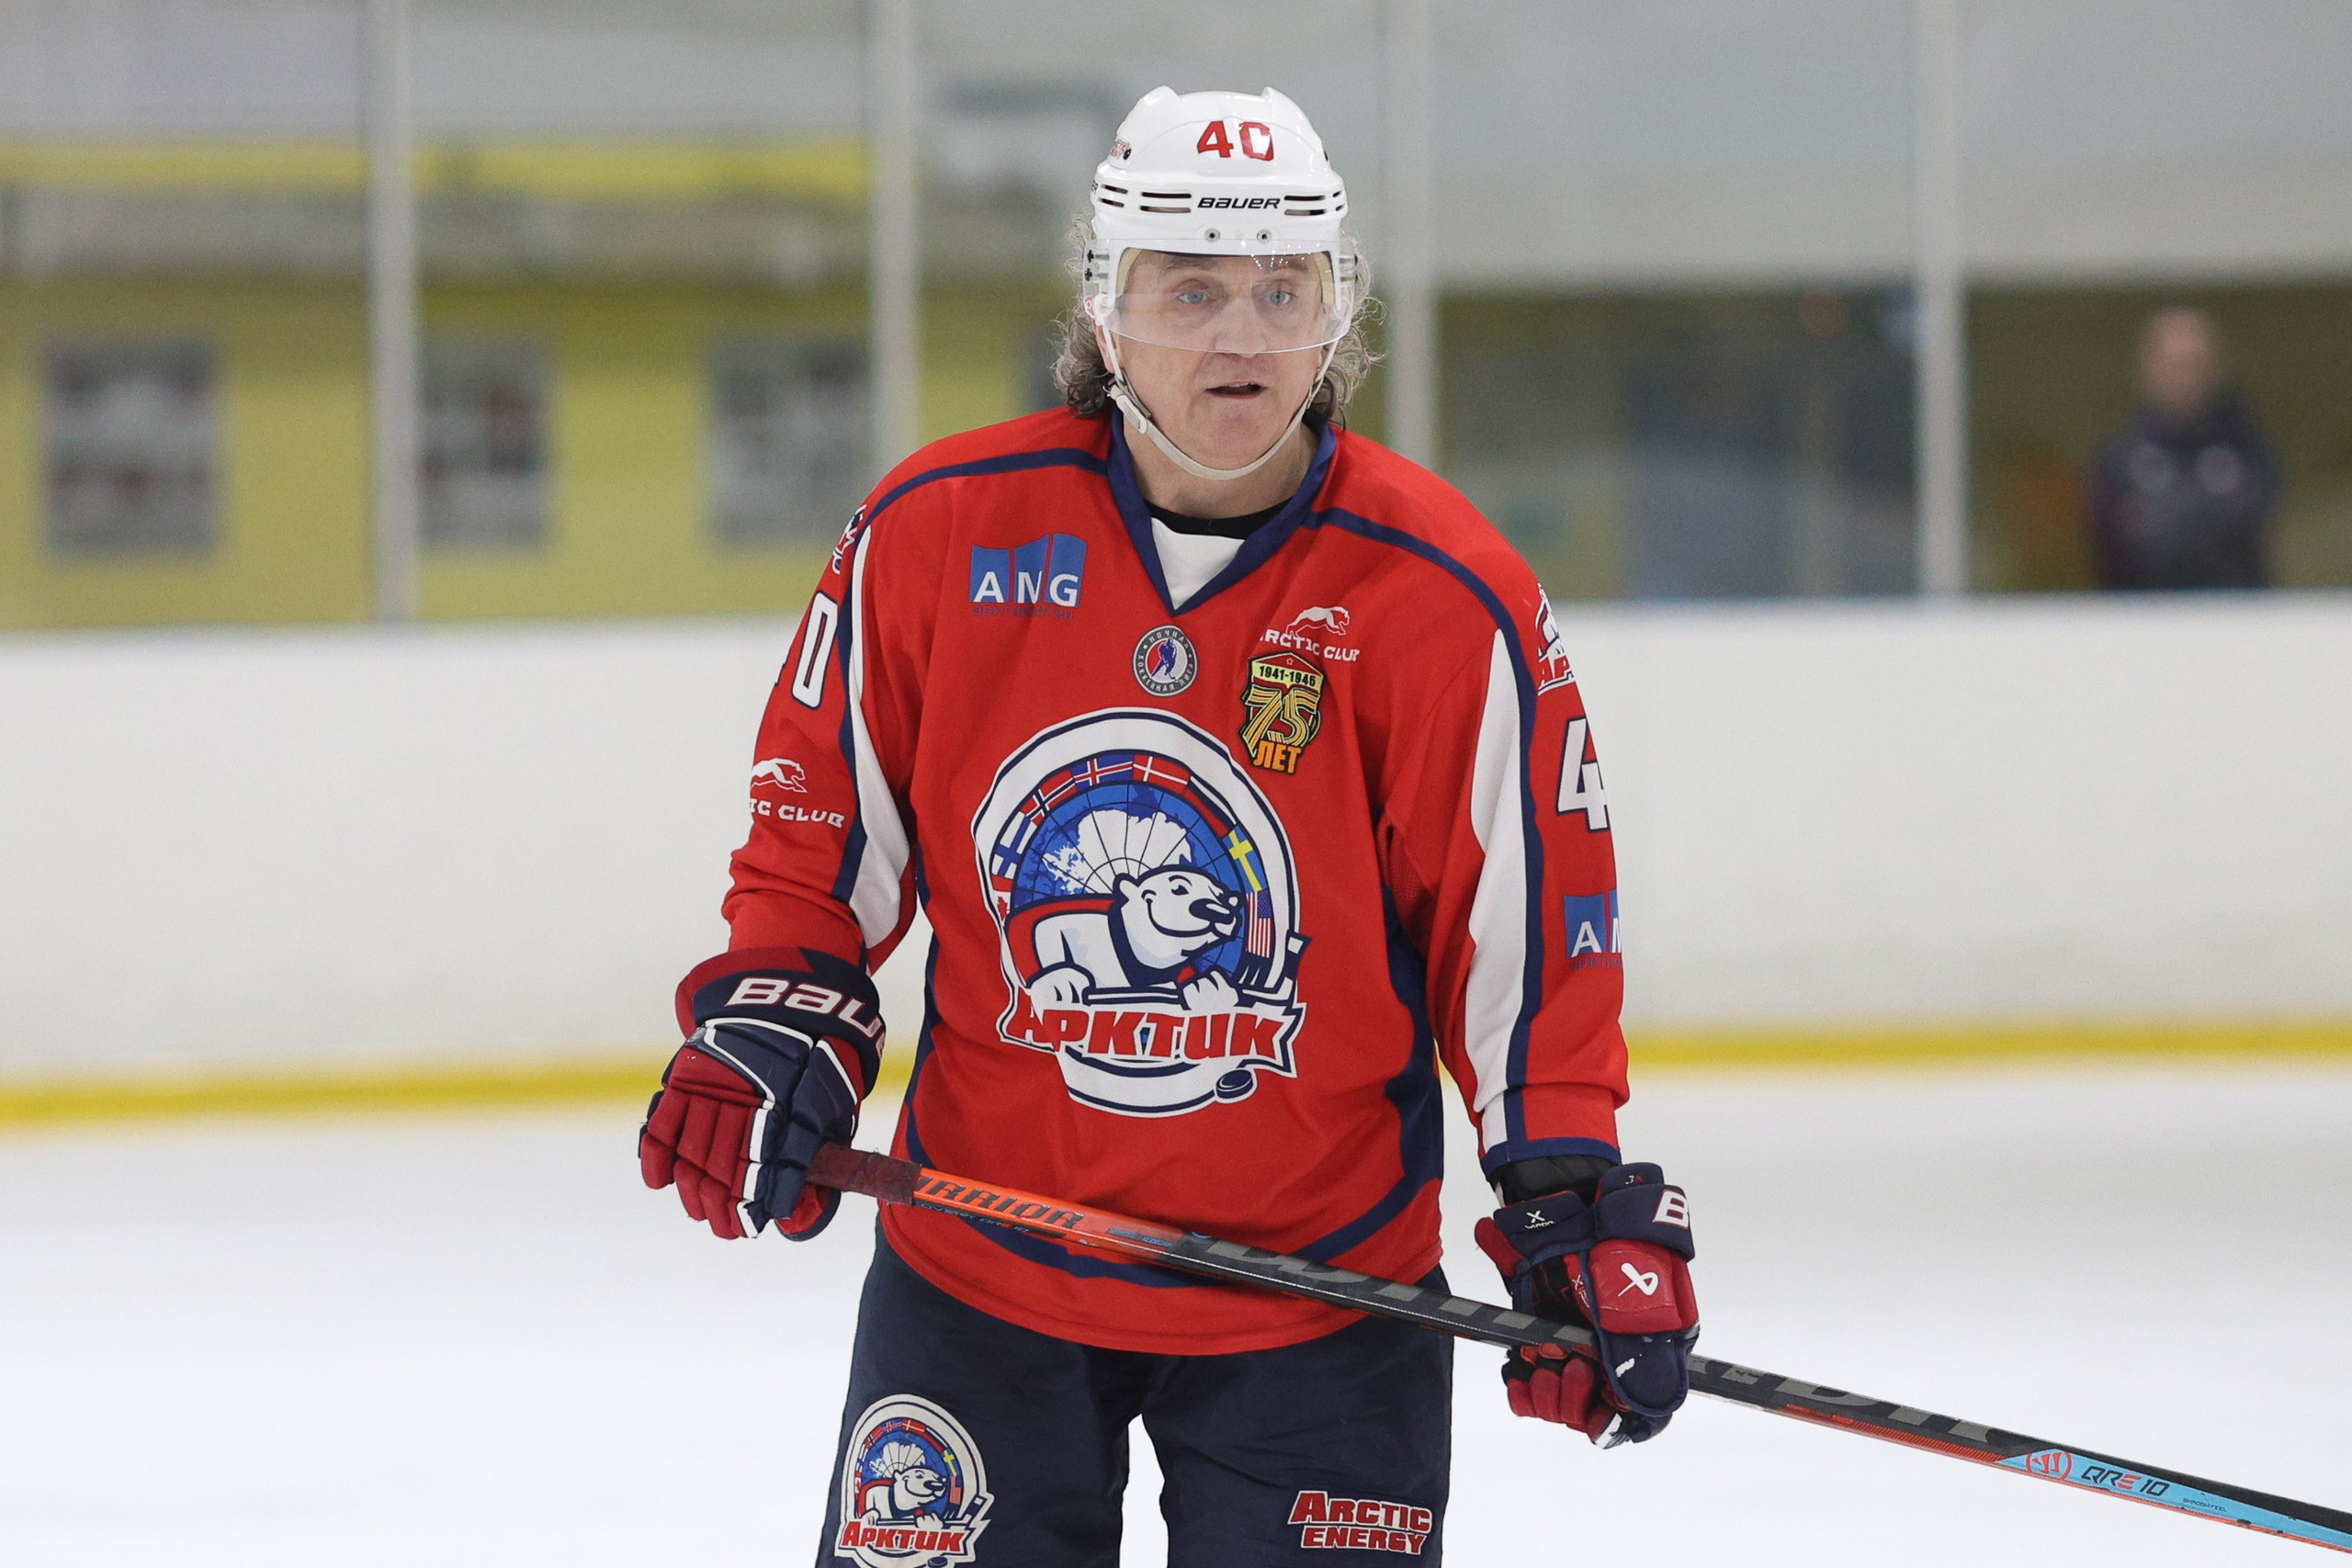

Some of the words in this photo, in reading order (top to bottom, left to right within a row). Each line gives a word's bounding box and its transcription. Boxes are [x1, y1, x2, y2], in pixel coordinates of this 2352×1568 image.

[1197, 120, 1274, 161] 40
[791, 590, 839, 710] 0
[1260, 629, 1320, 656] RCTIC
[1260, 665, 1316, 687] 1941-1945
[1254, 740, 1301, 773] ЛЕТ
[777, 804, 845, 829] CLUB
[2081, 1465, 2142, 1490] QRE
[2139, 1479, 2170, 1496] 10
[1288, 1491, 1432, 1534] ARCTIC
[842, 1520, 966, 1552] АРКТИК
[1301, 1525, 1427, 1555] ENERGY
